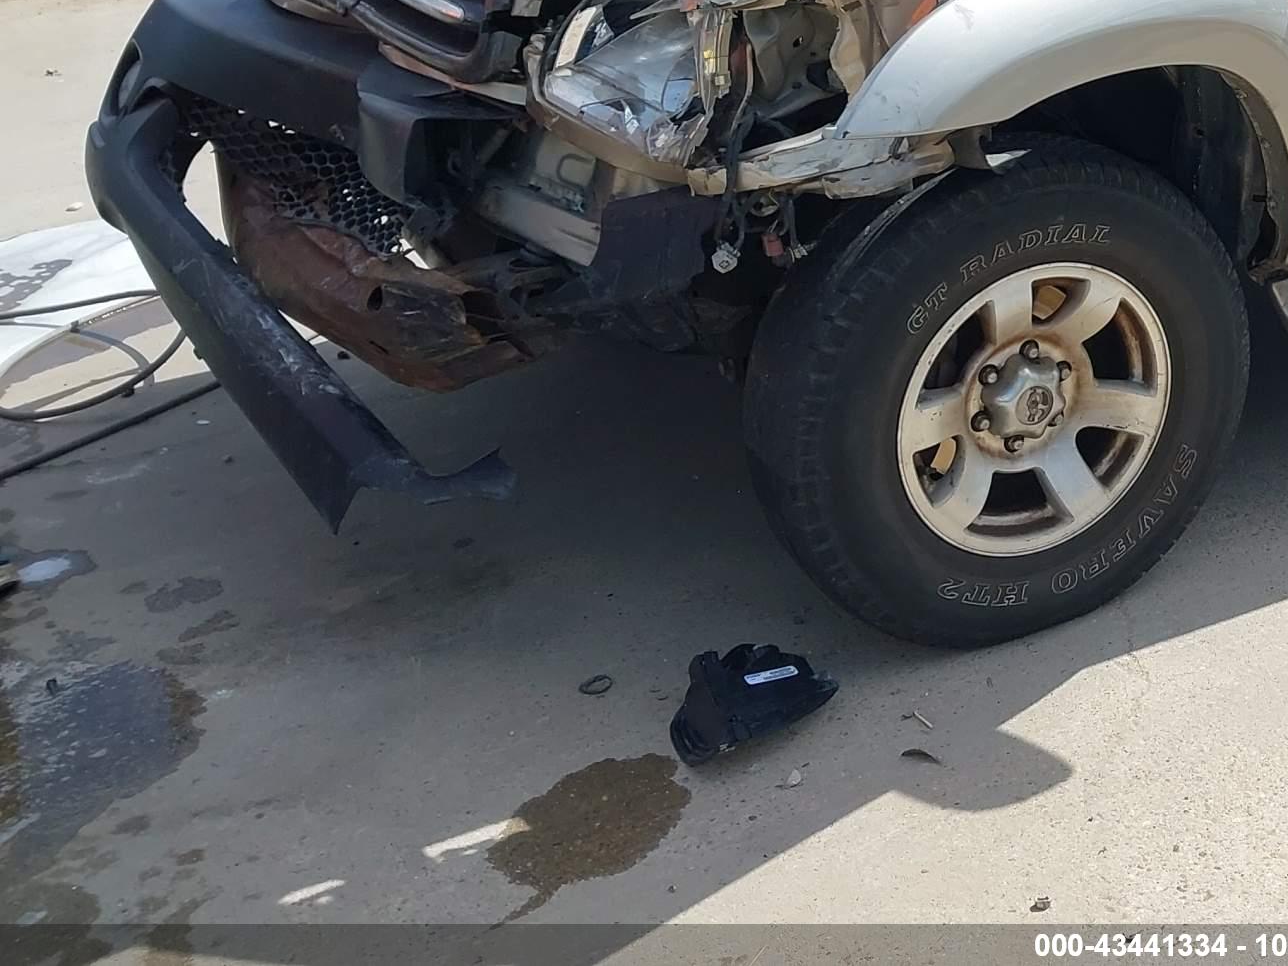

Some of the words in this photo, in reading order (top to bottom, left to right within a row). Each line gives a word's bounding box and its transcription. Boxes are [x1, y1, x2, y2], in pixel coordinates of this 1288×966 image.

[906, 282, 948, 334] GT
[959, 223, 1112, 284] RADIAL
[1051, 444, 1198, 594] SAVERO
[937, 577, 1029, 607] HT2
